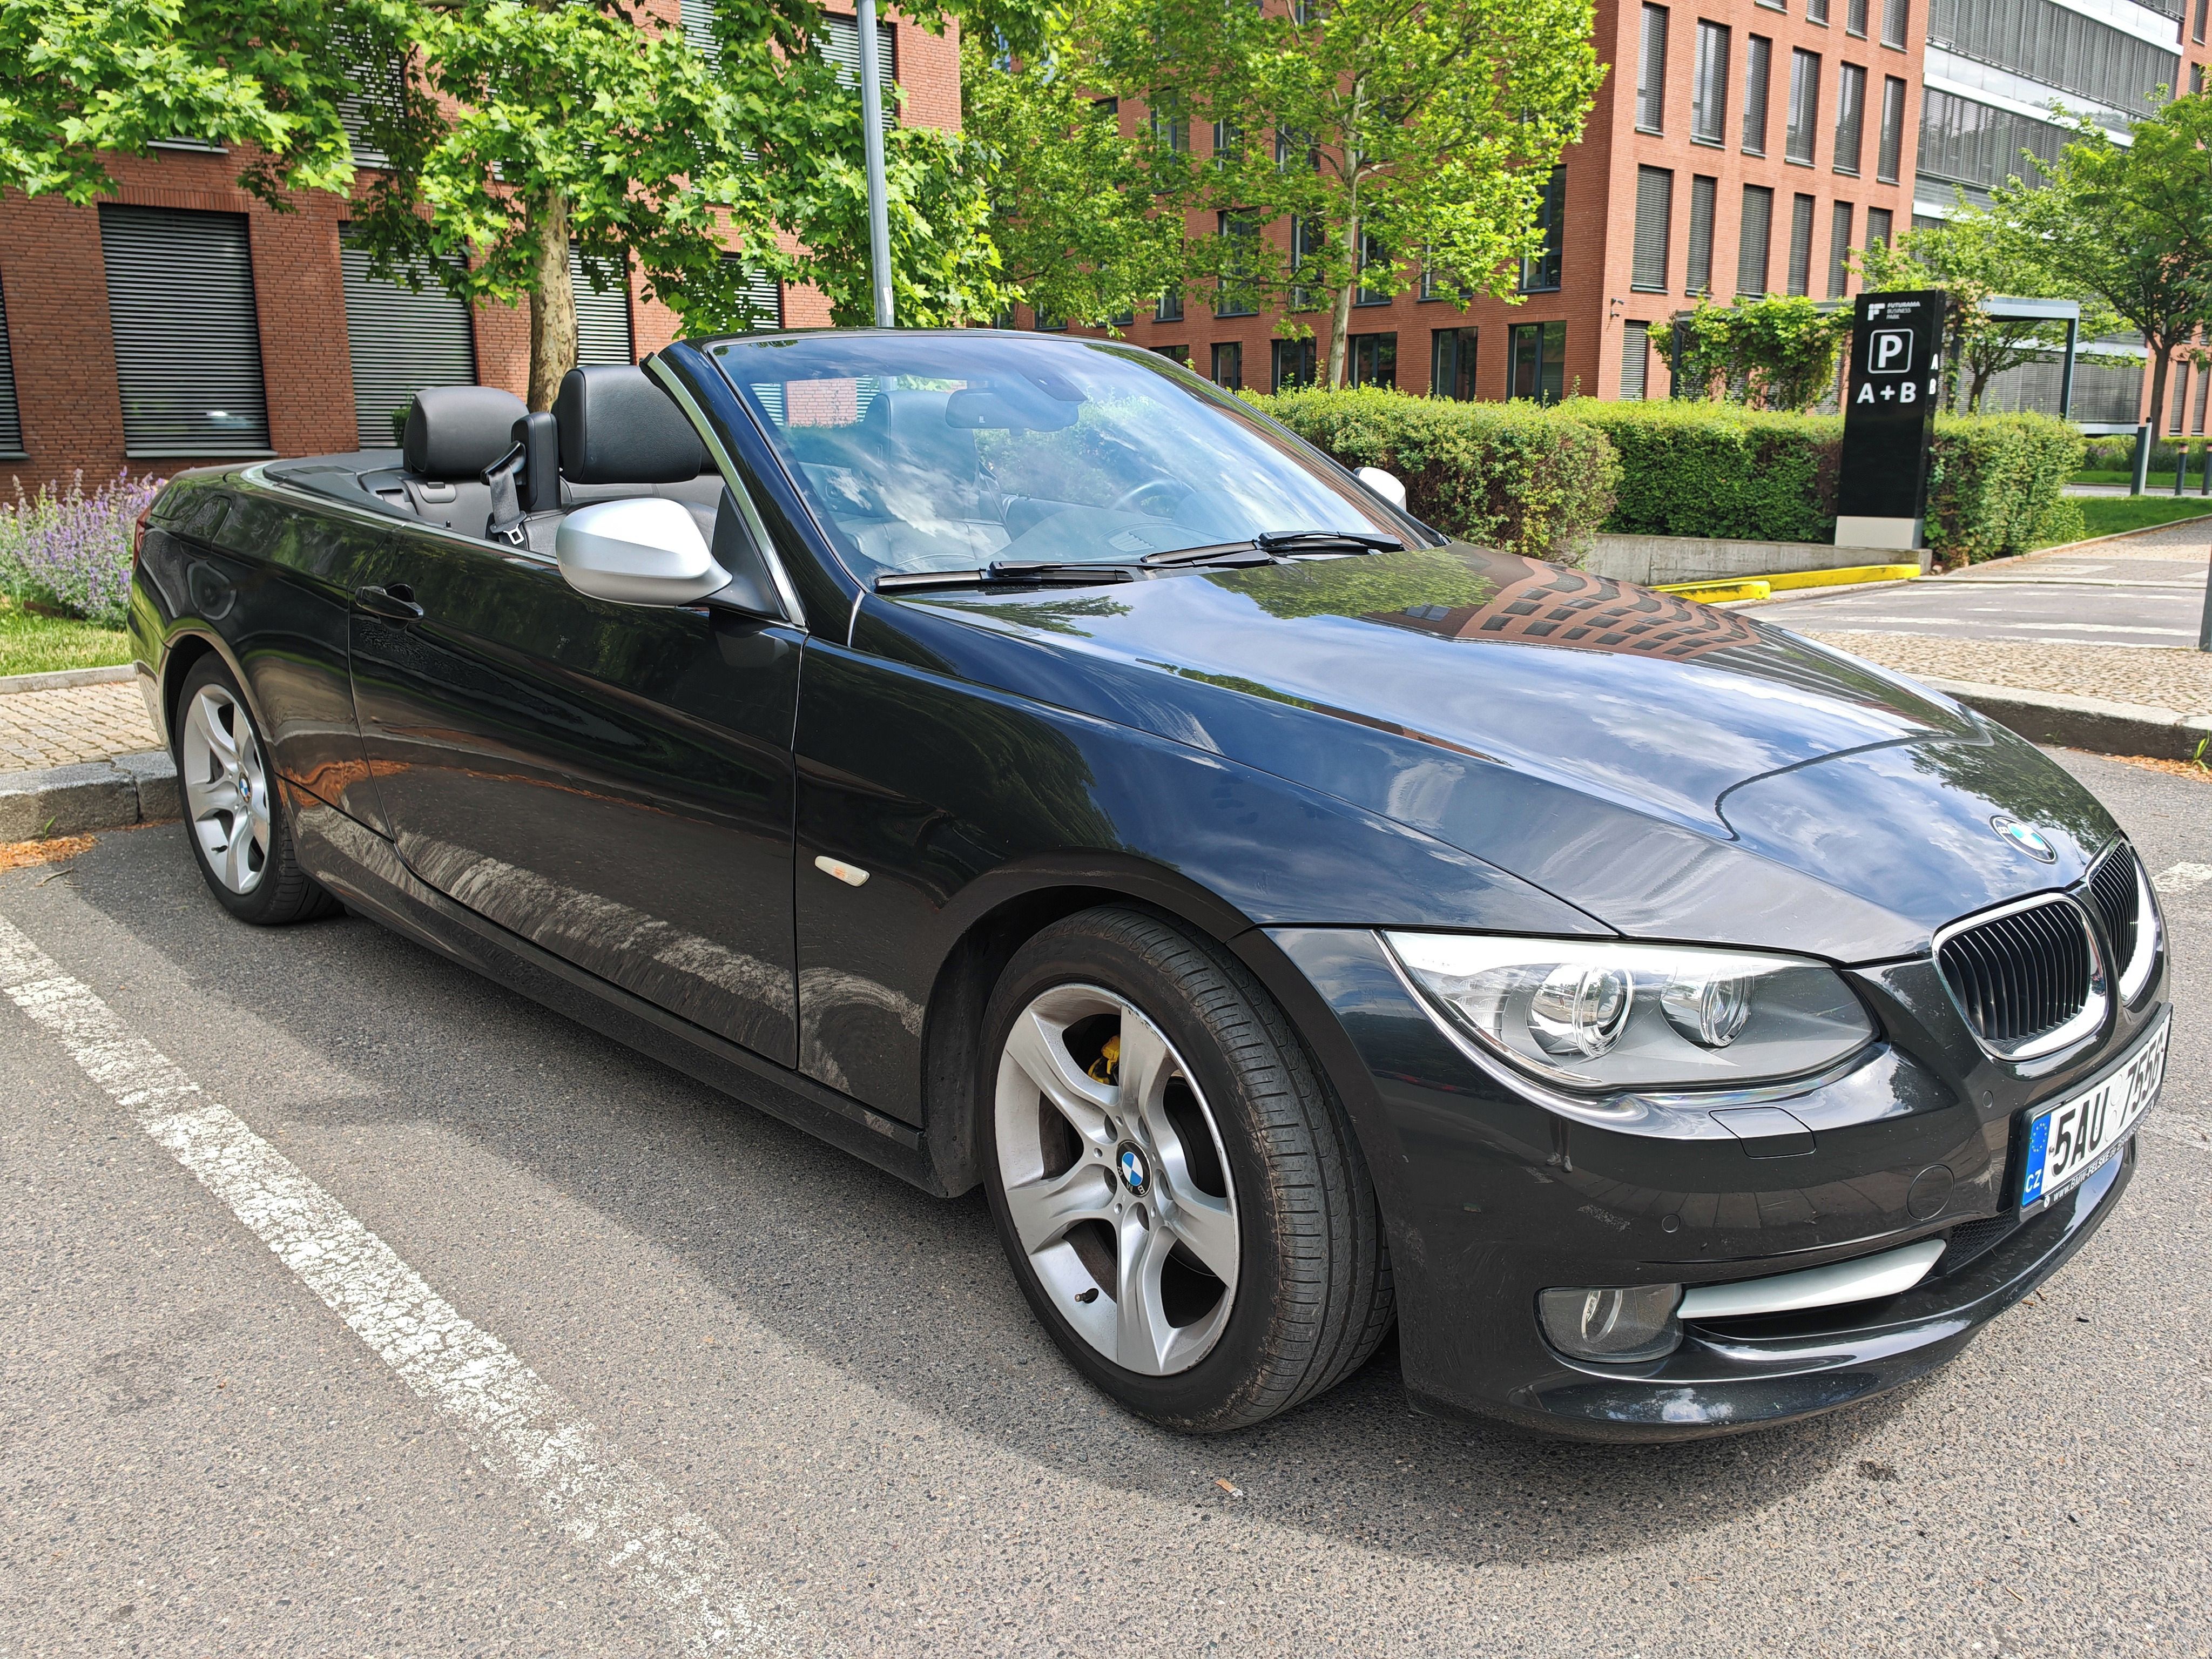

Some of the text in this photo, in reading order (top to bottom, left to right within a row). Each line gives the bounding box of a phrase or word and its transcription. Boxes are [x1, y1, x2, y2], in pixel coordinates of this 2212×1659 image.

[1878, 335, 1903, 368] P
[1930, 353, 1939, 370] A
[1856, 382, 1875, 403] A
[1900, 382, 1917, 403] B
[1928, 378, 1937, 395] B
[2052, 1085, 2110, 1177] 5AU
[2118, 1031, 2163, 1129] 7556
[1117, 1166, 1145, 1194] BMW
[2025, 1169, 2041, 1193] CZ
